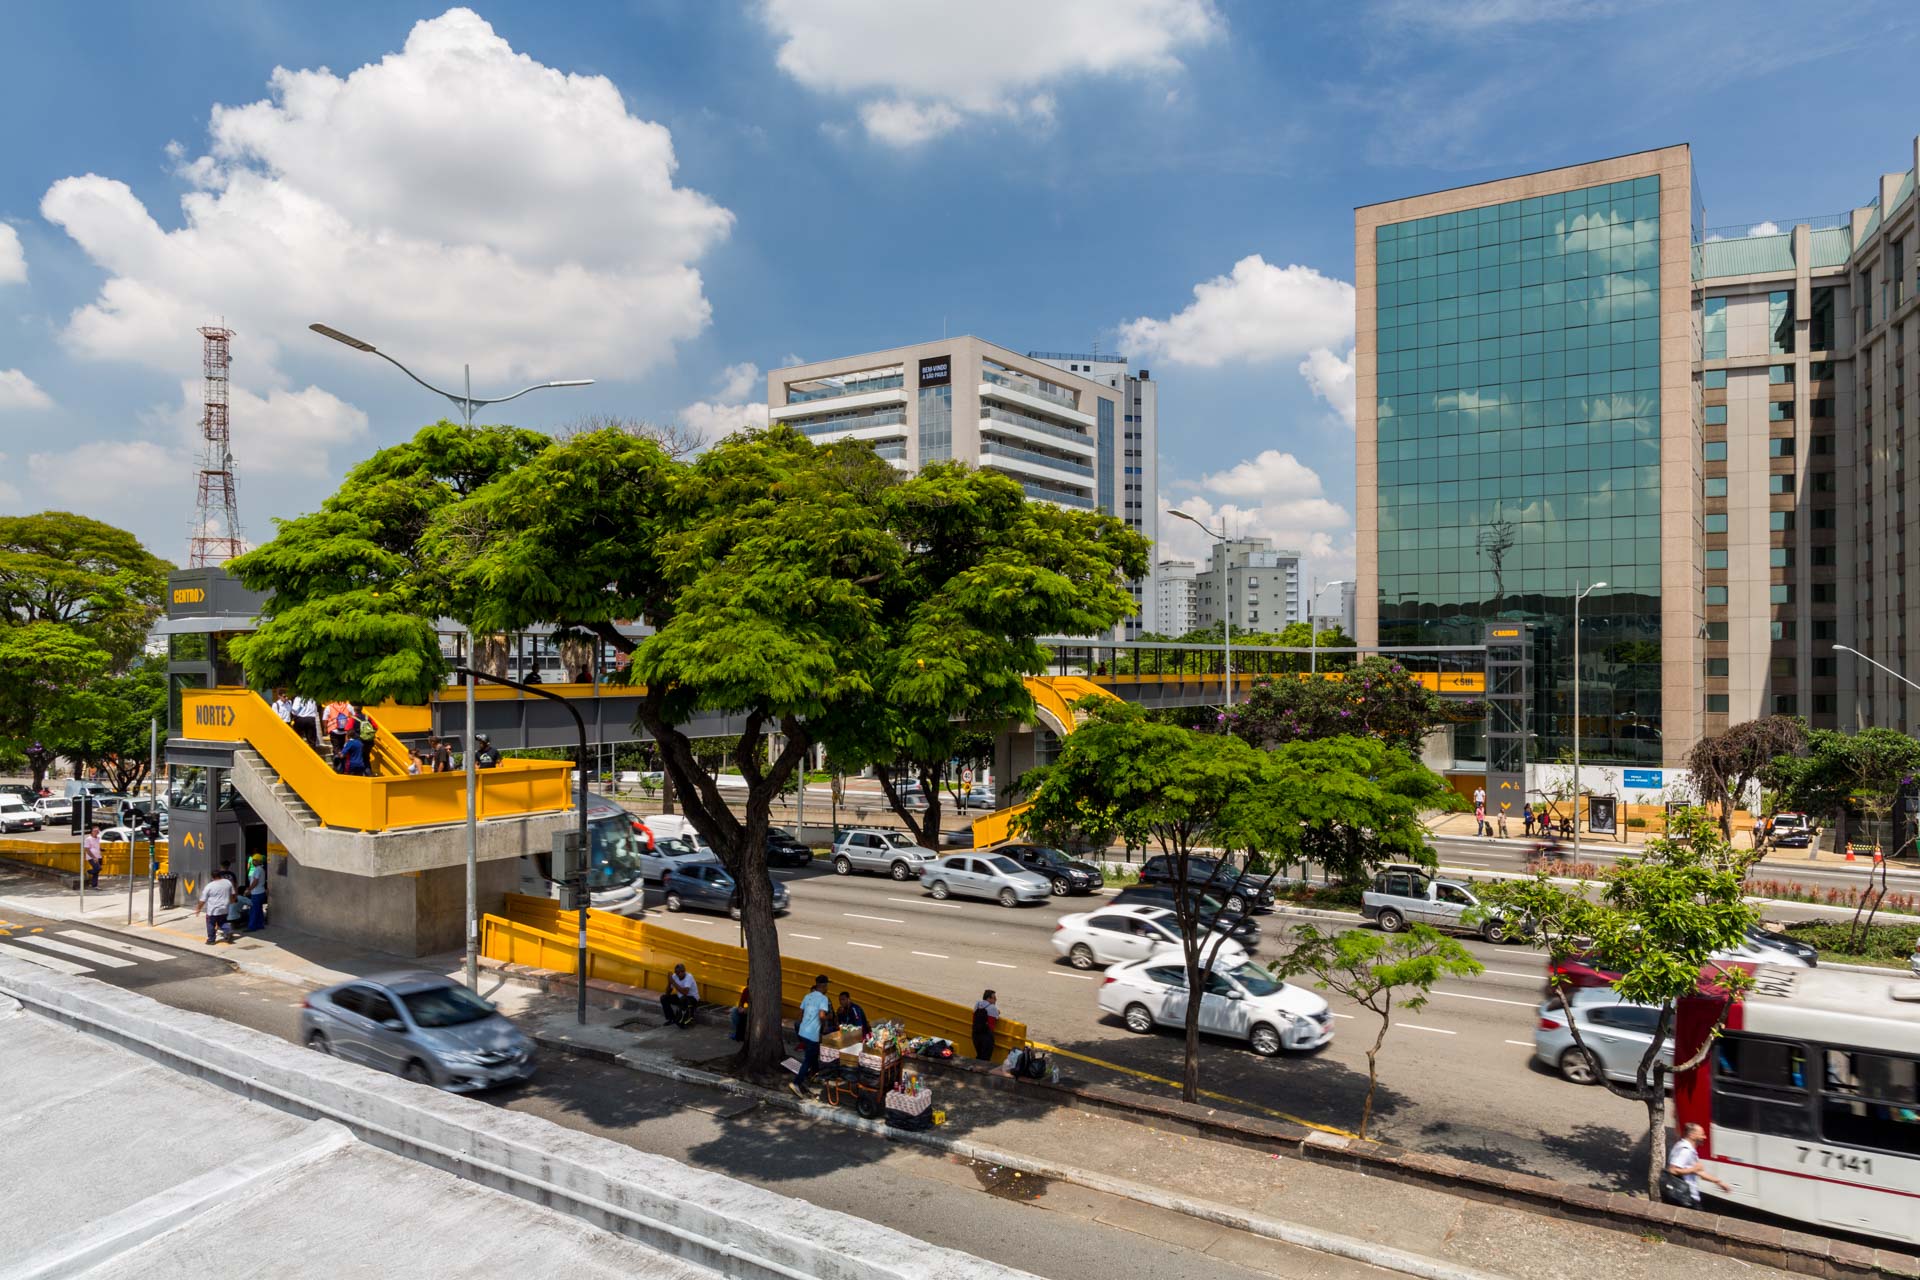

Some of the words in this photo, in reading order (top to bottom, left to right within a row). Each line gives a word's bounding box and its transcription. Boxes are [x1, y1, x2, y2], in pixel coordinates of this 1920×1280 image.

[922, 364, 947, 373] BEM-VINDO
[173, 588, 199, 604] CENTRO
[1460, 678, 1474, 686] SUL
[196, 704, 226, 726] NORTE
[1796, 1145, 1810, 1163] 7
[1819, 1150, 1872, 1175] 7141
